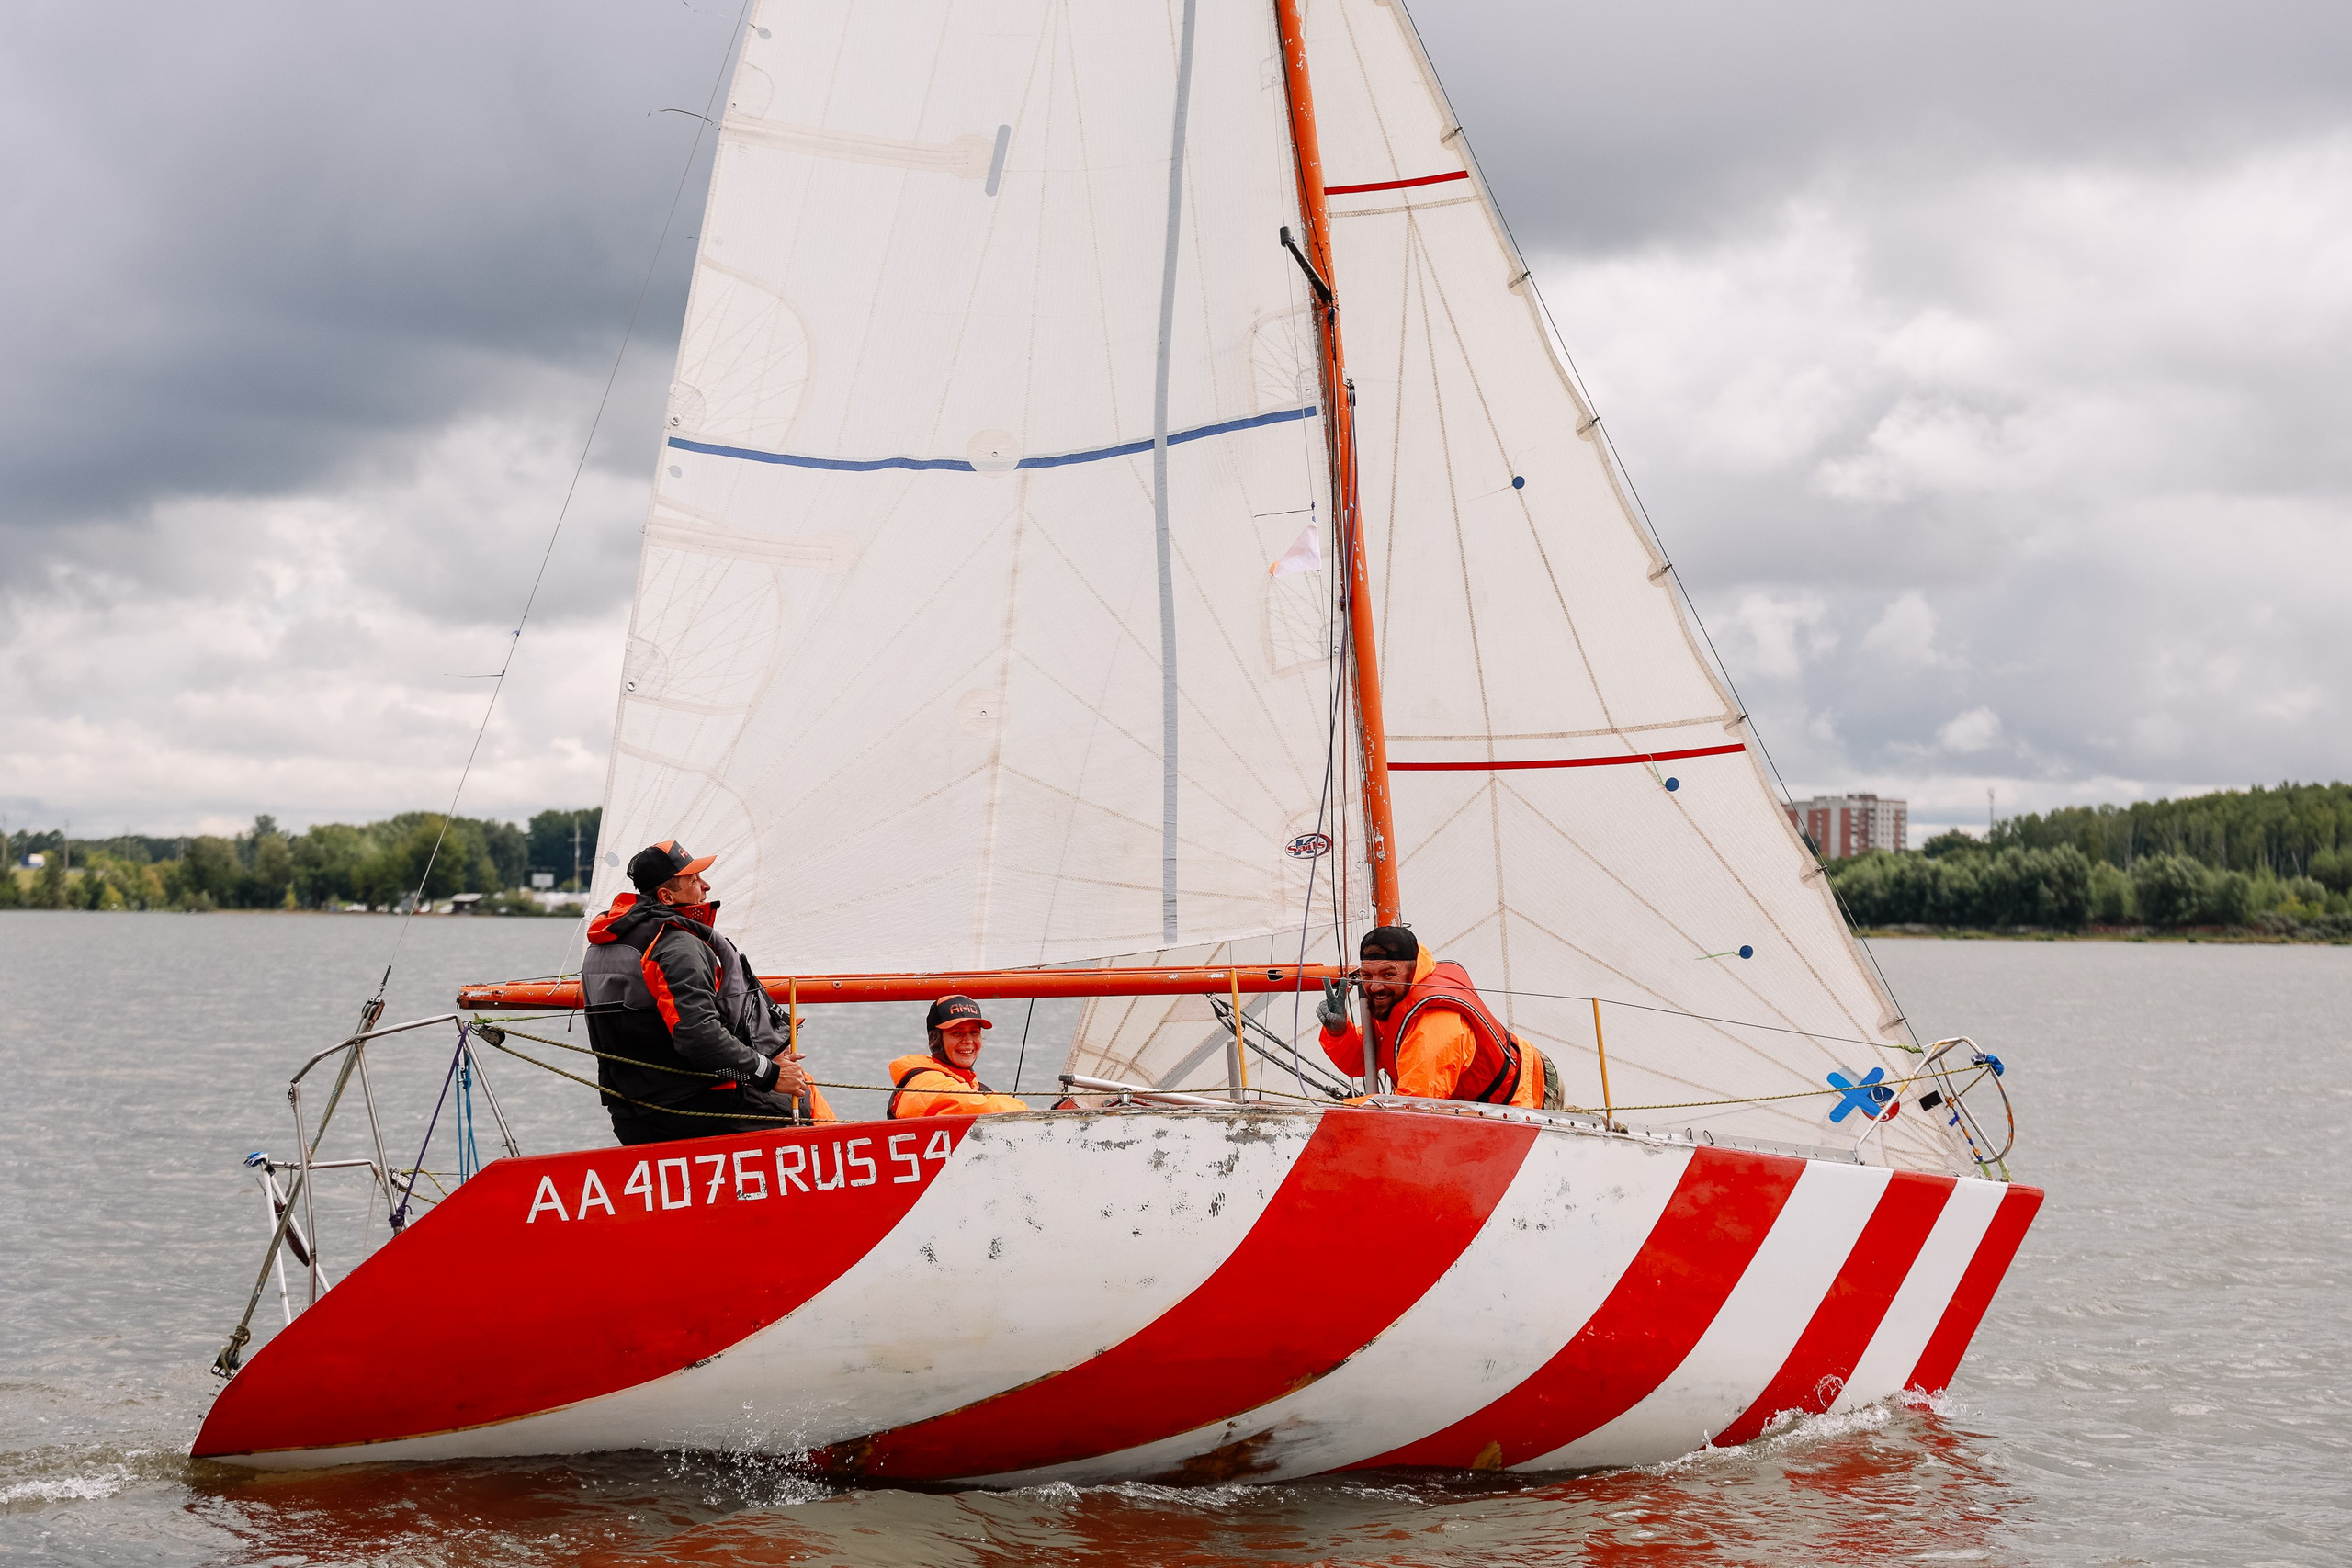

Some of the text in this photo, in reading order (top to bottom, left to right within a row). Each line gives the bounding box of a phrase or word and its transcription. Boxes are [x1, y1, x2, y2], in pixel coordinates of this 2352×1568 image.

[1287, 841, 1325, 854] Sails
[526, 1130, 952, 1224] AA 4076 RUS 54
